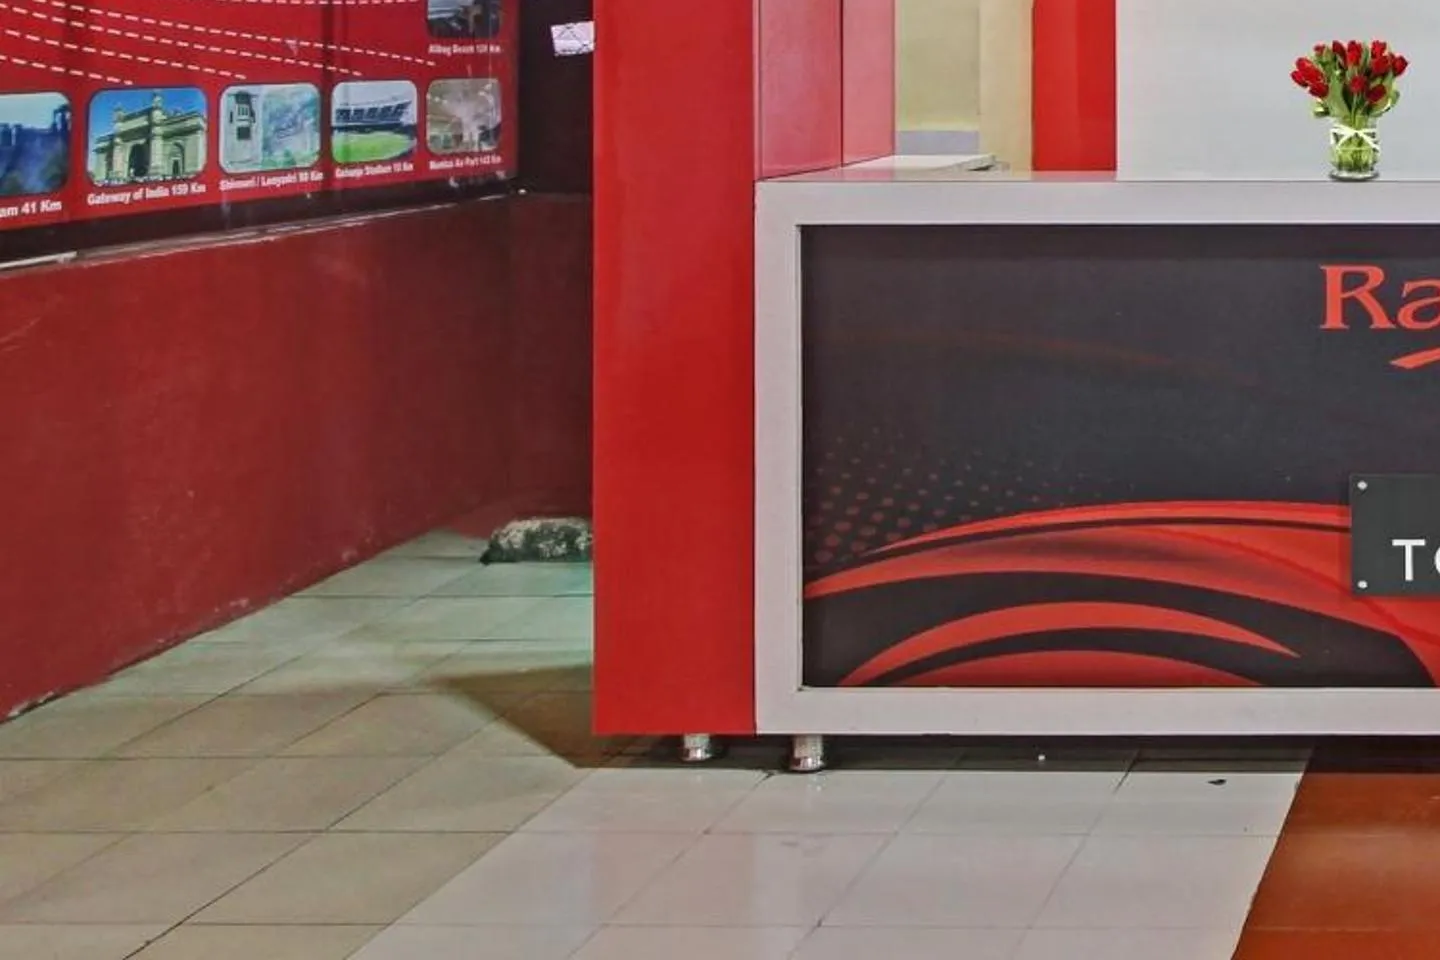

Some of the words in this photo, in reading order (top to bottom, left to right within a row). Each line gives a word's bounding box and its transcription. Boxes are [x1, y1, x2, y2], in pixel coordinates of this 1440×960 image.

[87, 193, 131, 205] Gateway
[21, 202, 36, 214] 41
[40, 200, 62, 213] Km
